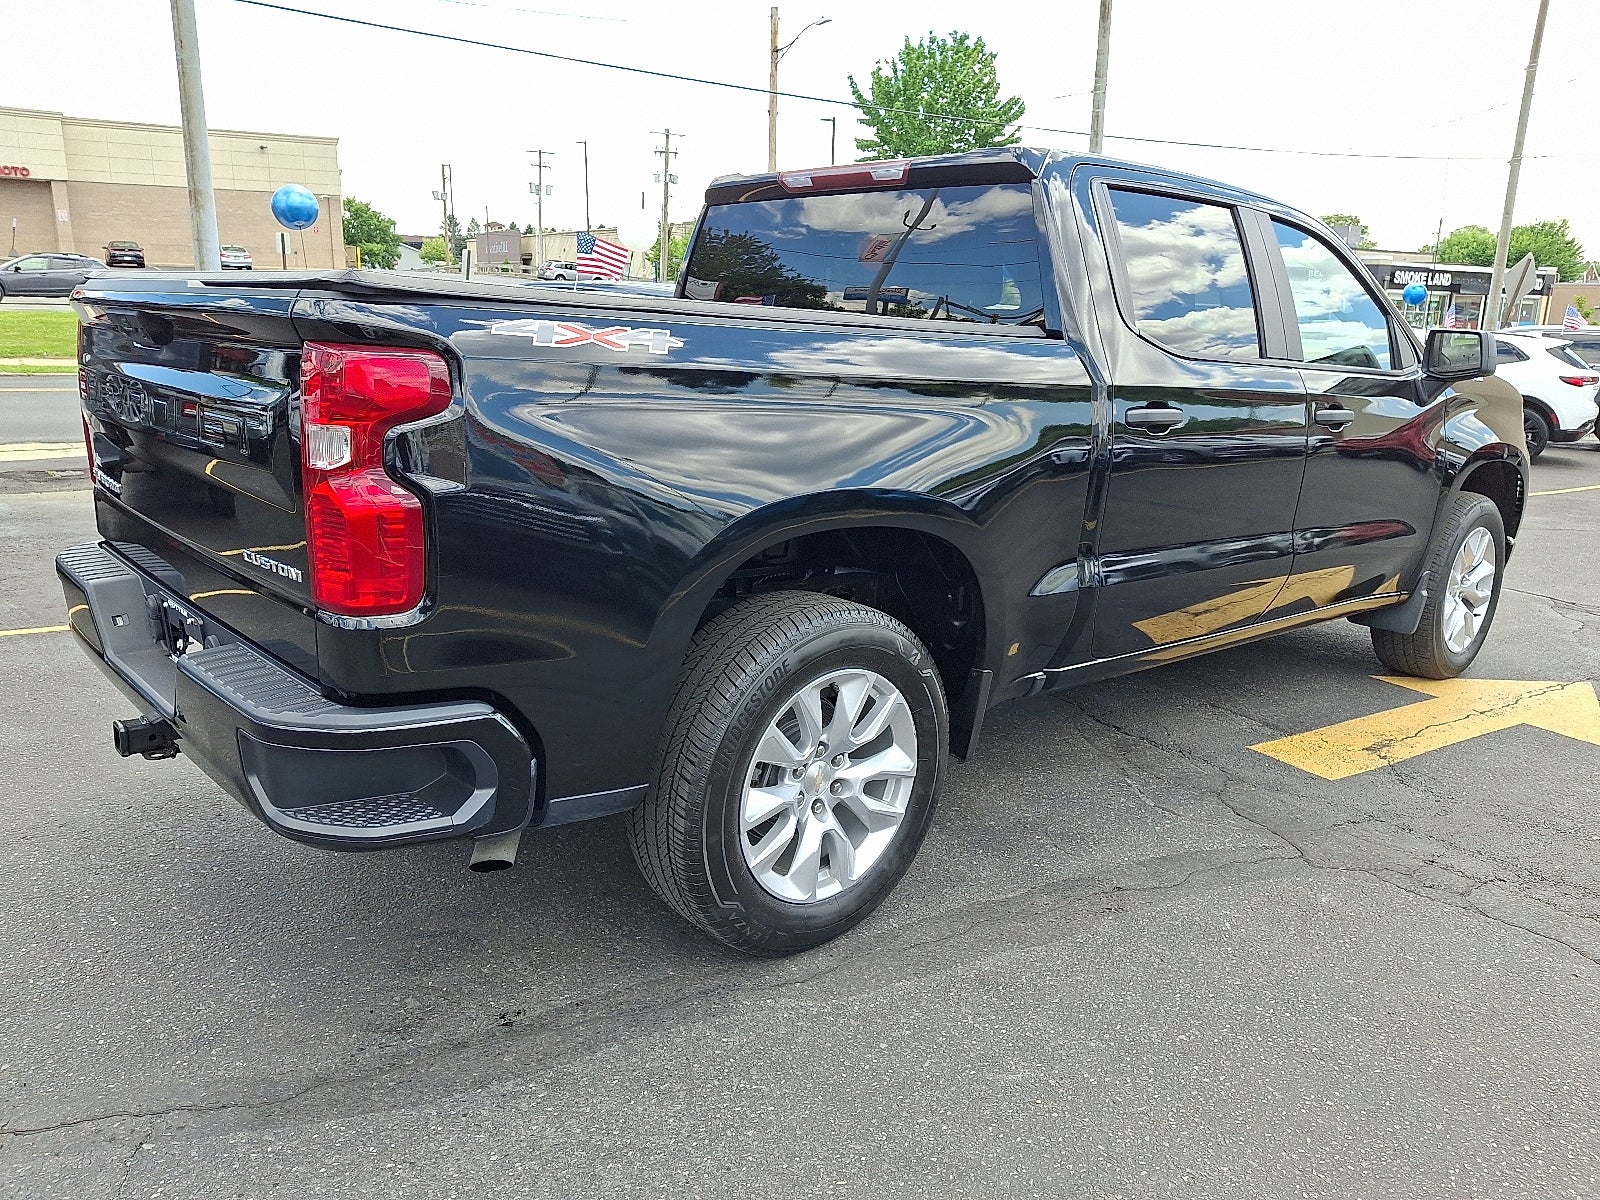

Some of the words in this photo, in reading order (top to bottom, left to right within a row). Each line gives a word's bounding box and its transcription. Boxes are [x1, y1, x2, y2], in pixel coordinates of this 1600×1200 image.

[0, 165, 30, 177] OTO
[1393, 270, 1428, 285] SMOKE
[1427, 272, 1452, 286] LAND
[242, 549, 303, 582] CUSTOM
